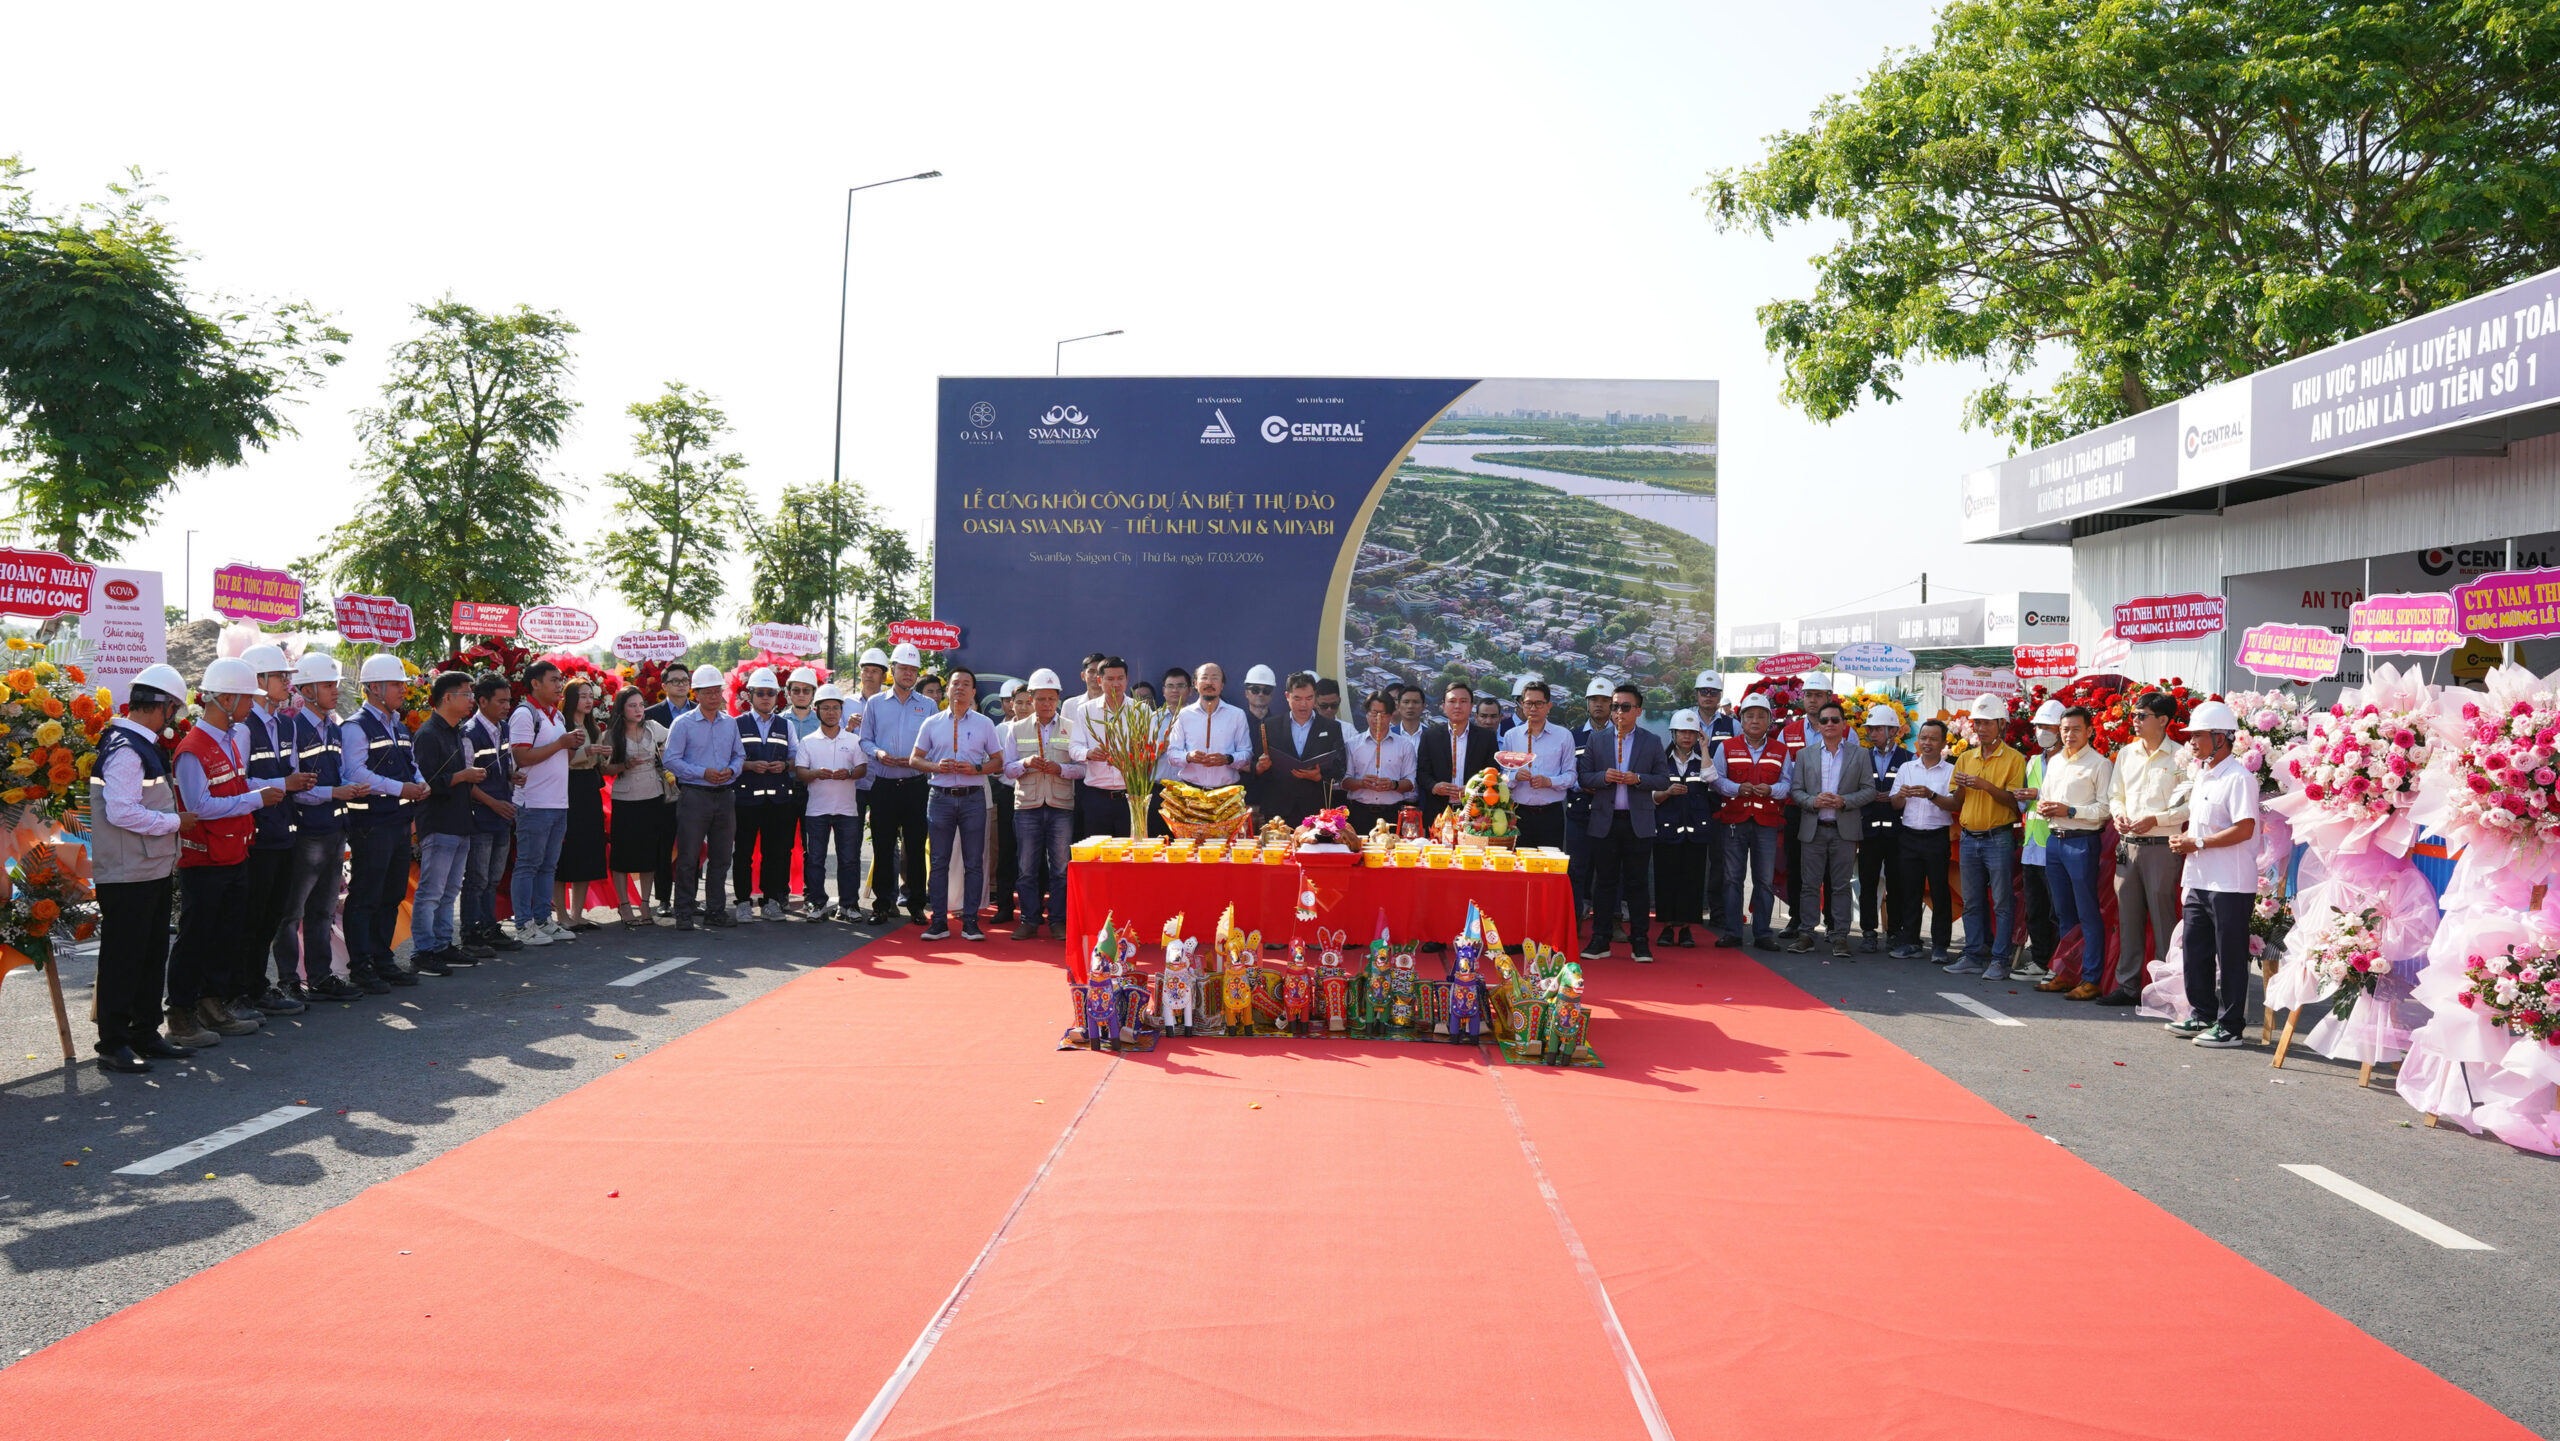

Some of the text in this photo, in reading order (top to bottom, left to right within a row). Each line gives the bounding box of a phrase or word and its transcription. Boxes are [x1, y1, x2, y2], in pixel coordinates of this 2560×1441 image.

[2292, 292, 2560, 410] KHU VỰC HUẤN LUYỆN AN TOÀ
[2310, 344, 2537, 443] AN TOÀN LÀ ƯU TIÊN SỐ 1
[960, 430, 1003, 441] OASIA
[1028, 428, 1100, 439] SWANBAY
[1291, 423, 1364, 436] CENTRAL
[2201, 420, 2243, 446] CENTRAL
[2028, 468, 2040, 489] AN
[2041, 457, 2063, 484] TOÀN
[2075, 446, 2103, 475] TRÁCH
[2105, 435, 2136, 467] NHIỆM
[2084, 478, 2111, 502] RIÊNG
[2112, 470, 2124, 495] AI
[963, 487, 1335, 513] LỄ CÚNG KHỞI CÔNG DỰ ÁN BIỆT THỰ ĐẢO
[963, 518, 1017, 534] OASIA
[1021, 518, 1106, 534] SWANBAY
[1124, 513, 1163, 535] TIỂU
[1167, 518, 1204, 535] KHU
[1207, 519, 1252, 535] SUMI
[1256, 519, 1268, 535] &
[1273, 519, 1334, 535] MIYABI
[1029, 551, 1072, 565] SwanBay
[1076, 551, 1111, 565] Saigon
[1113, 551, 1133, 565] City
[1181, 552, 1203, 565] ngày
[1207, 551, 1264, 563] 17.03.2026
[2457, 549, 2552, 569] CENTRAL
[49, 567, 90, 588] NHÂN
[16, 585, 45, 605] KHỞI
[47, 590, 82, 609] CÔNG
[110, 585, 135, 597] KOVA
[2301, 587, 2365, 610] AN TOÀ
[2464, 588, 2494, 610] CTY
[2496, 585, 2532, 608] NAM
[477, 606, 510, 615] NIPPON
[479, 613, 504, 622] PAINT
[2040, 615, 2070, 623] CENTRA
[2116, 600, 2222, 622] CTY TNHH MTV TẠO PHƯƠNG
[2367, 608, 2395, 625] GLOBAL
[2395, 608, 2431, 625] SERVICES
[2466, 612, 2498, 631] CHÚC
[2499, 610, 2538, 629] MỪNG
[2540, 604, 2556, 624] LỄ
[103, 626, 124, 639] Chúc
[2120, 624, 2140, 636] CHÚC
[2140, 622, 2164, 635] MỪNG
[2175, 617, 2195, 631] KHỞI
[2196, 617, 2220, 630] CÔNG
[127, 643, 147, 652] CÔNG
[98, 666, 118, 674] OASIA
